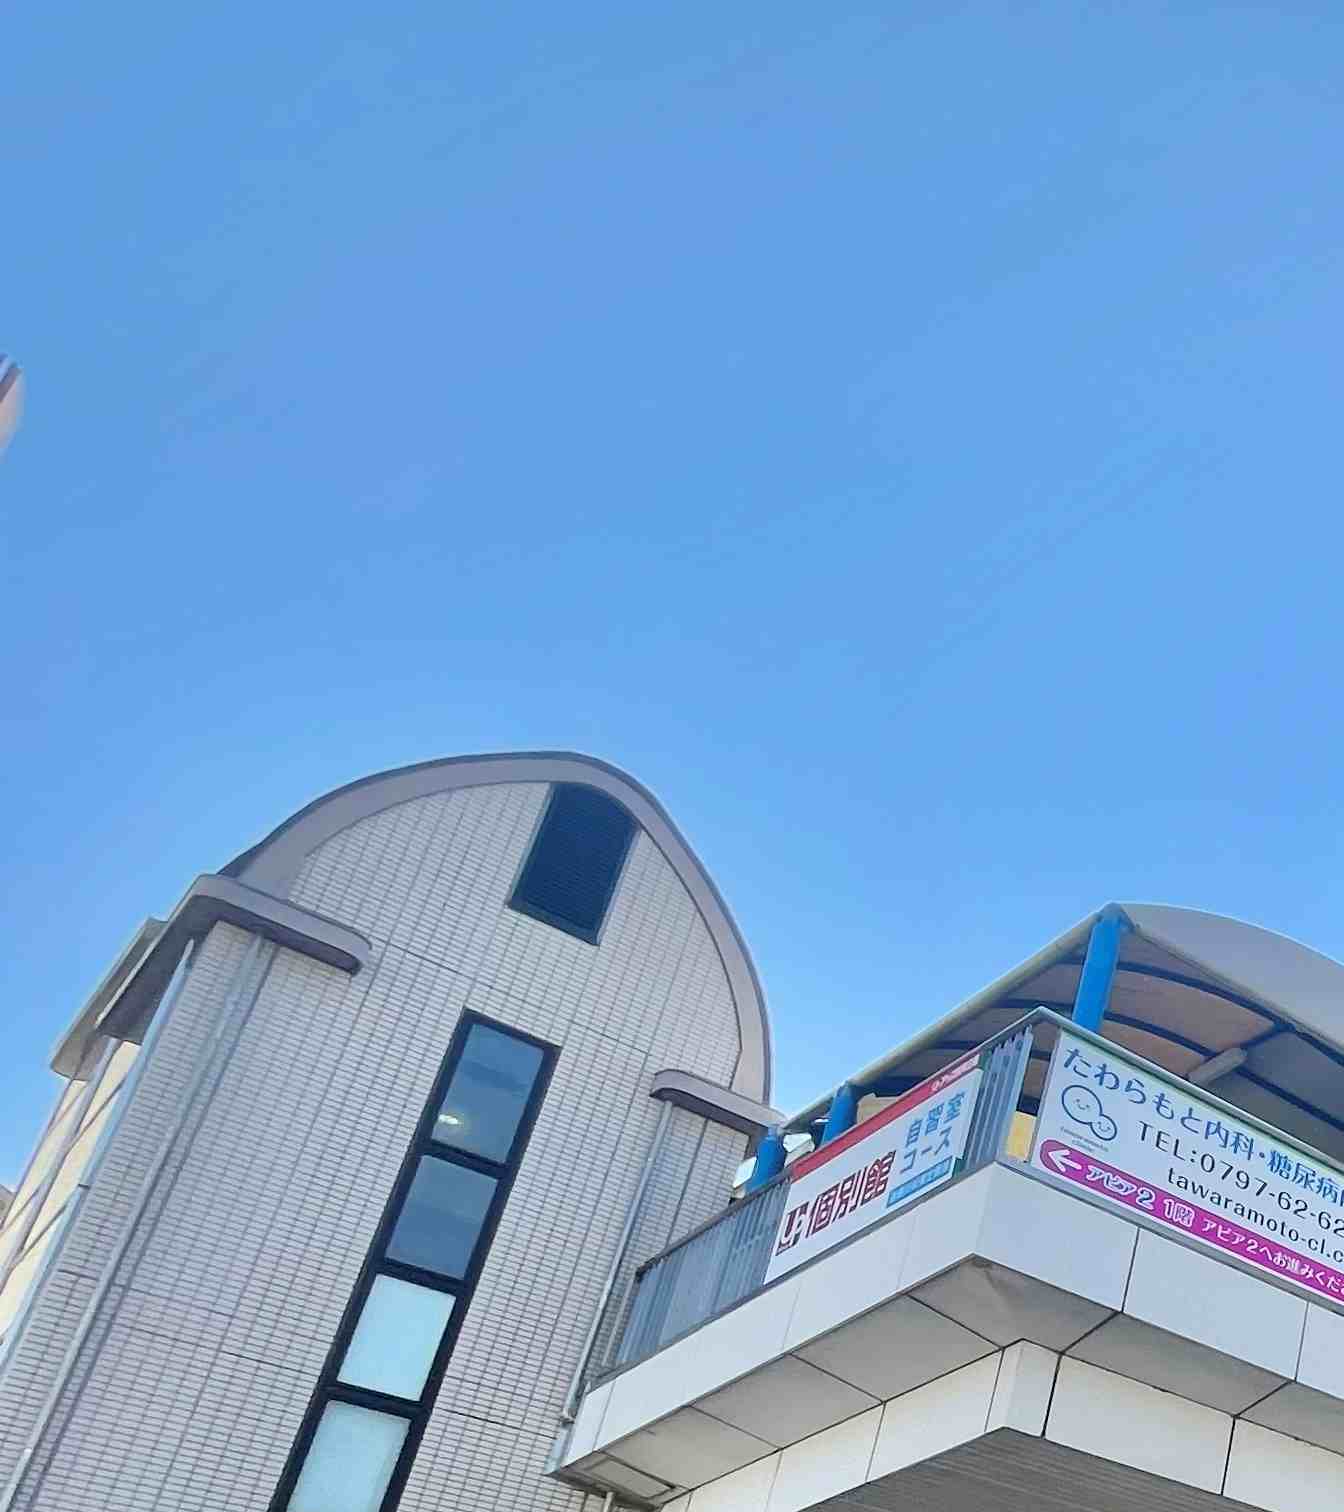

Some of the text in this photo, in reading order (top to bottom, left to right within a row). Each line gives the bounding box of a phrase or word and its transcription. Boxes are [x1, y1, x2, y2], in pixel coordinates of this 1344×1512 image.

[905, 1091, 966, 1148] 自習室
[899, 1127, 953, 1174] コース
